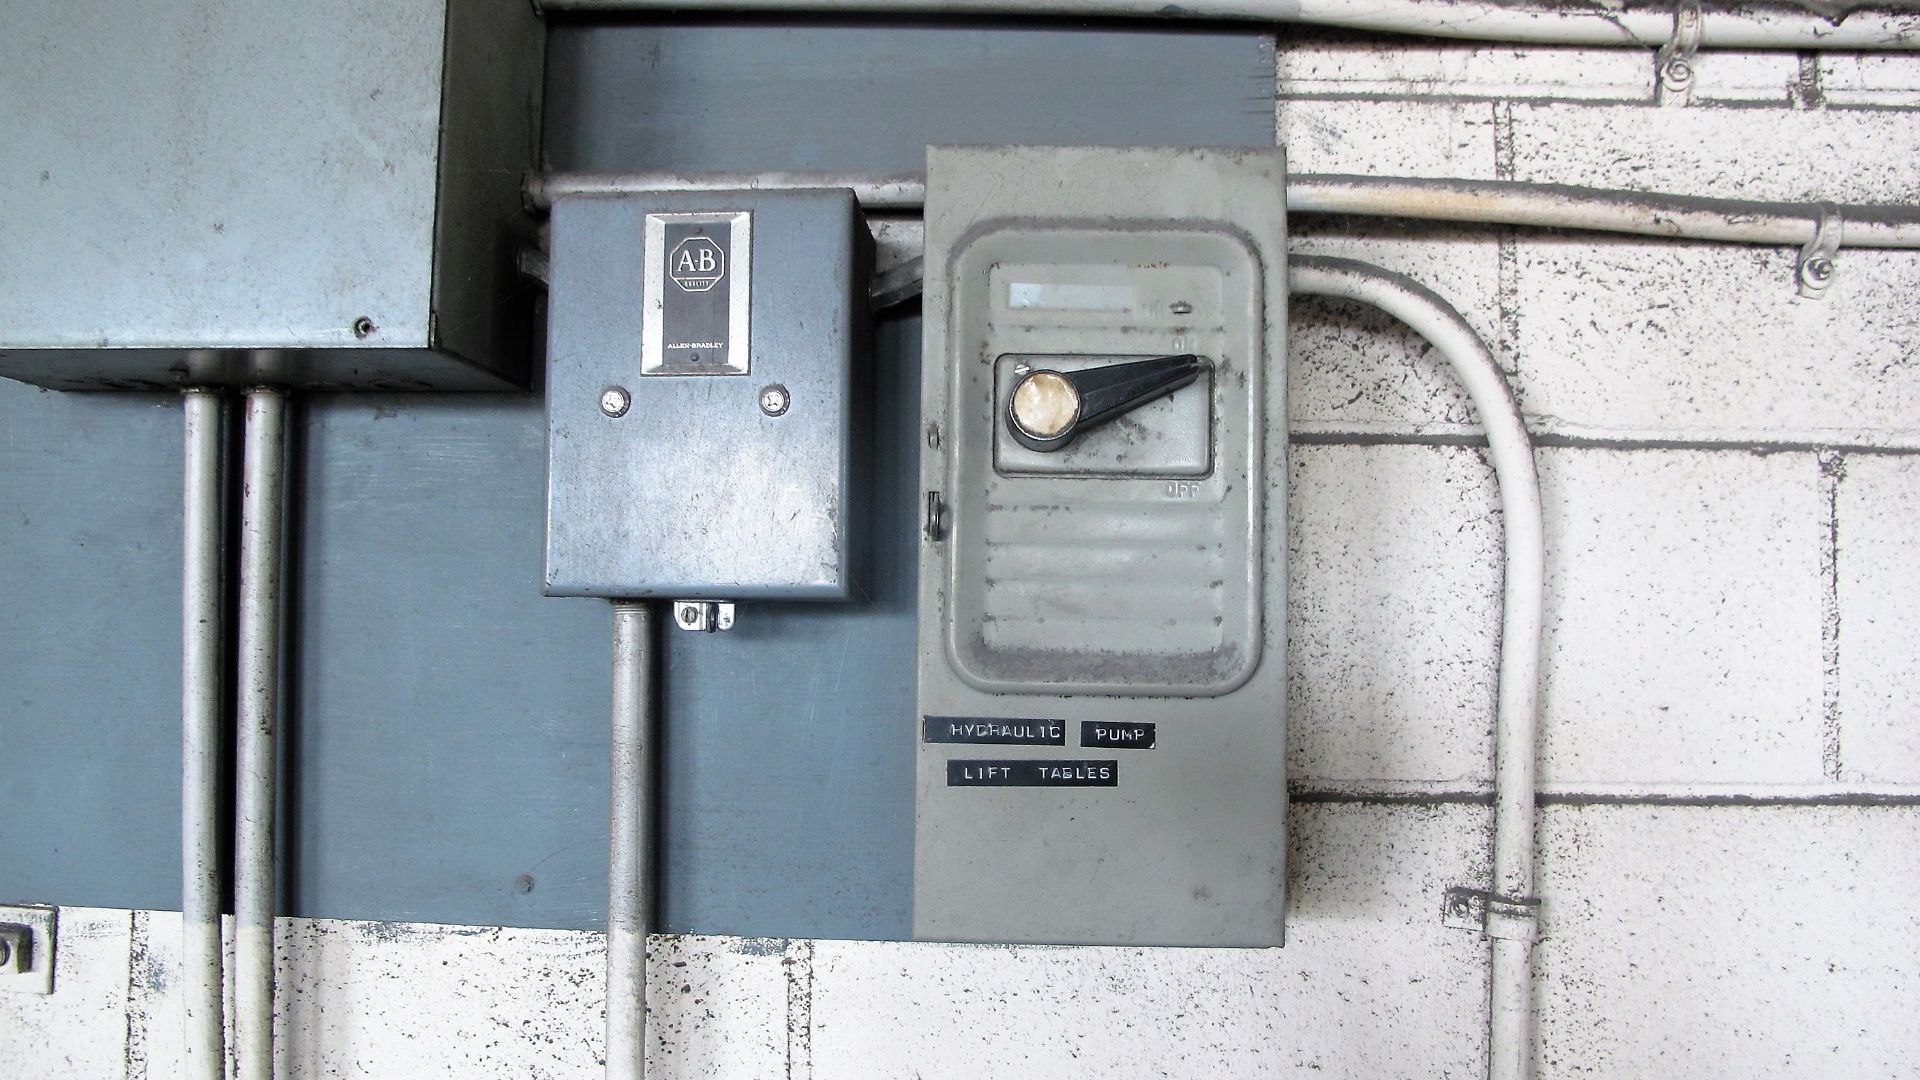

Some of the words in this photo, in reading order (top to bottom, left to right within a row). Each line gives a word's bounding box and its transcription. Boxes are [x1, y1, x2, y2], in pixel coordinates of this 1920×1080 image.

[676, 248, 717, 272] A-B
[1167, 480, 1201, 498] OFF
[951, 723, 1061, 739] HYDRAULIC
[1096, 728, 1146, 741] PUMP
[964, 767, 1012, 780] LIFT
[1039, 767, 1111, 780] TABLES
